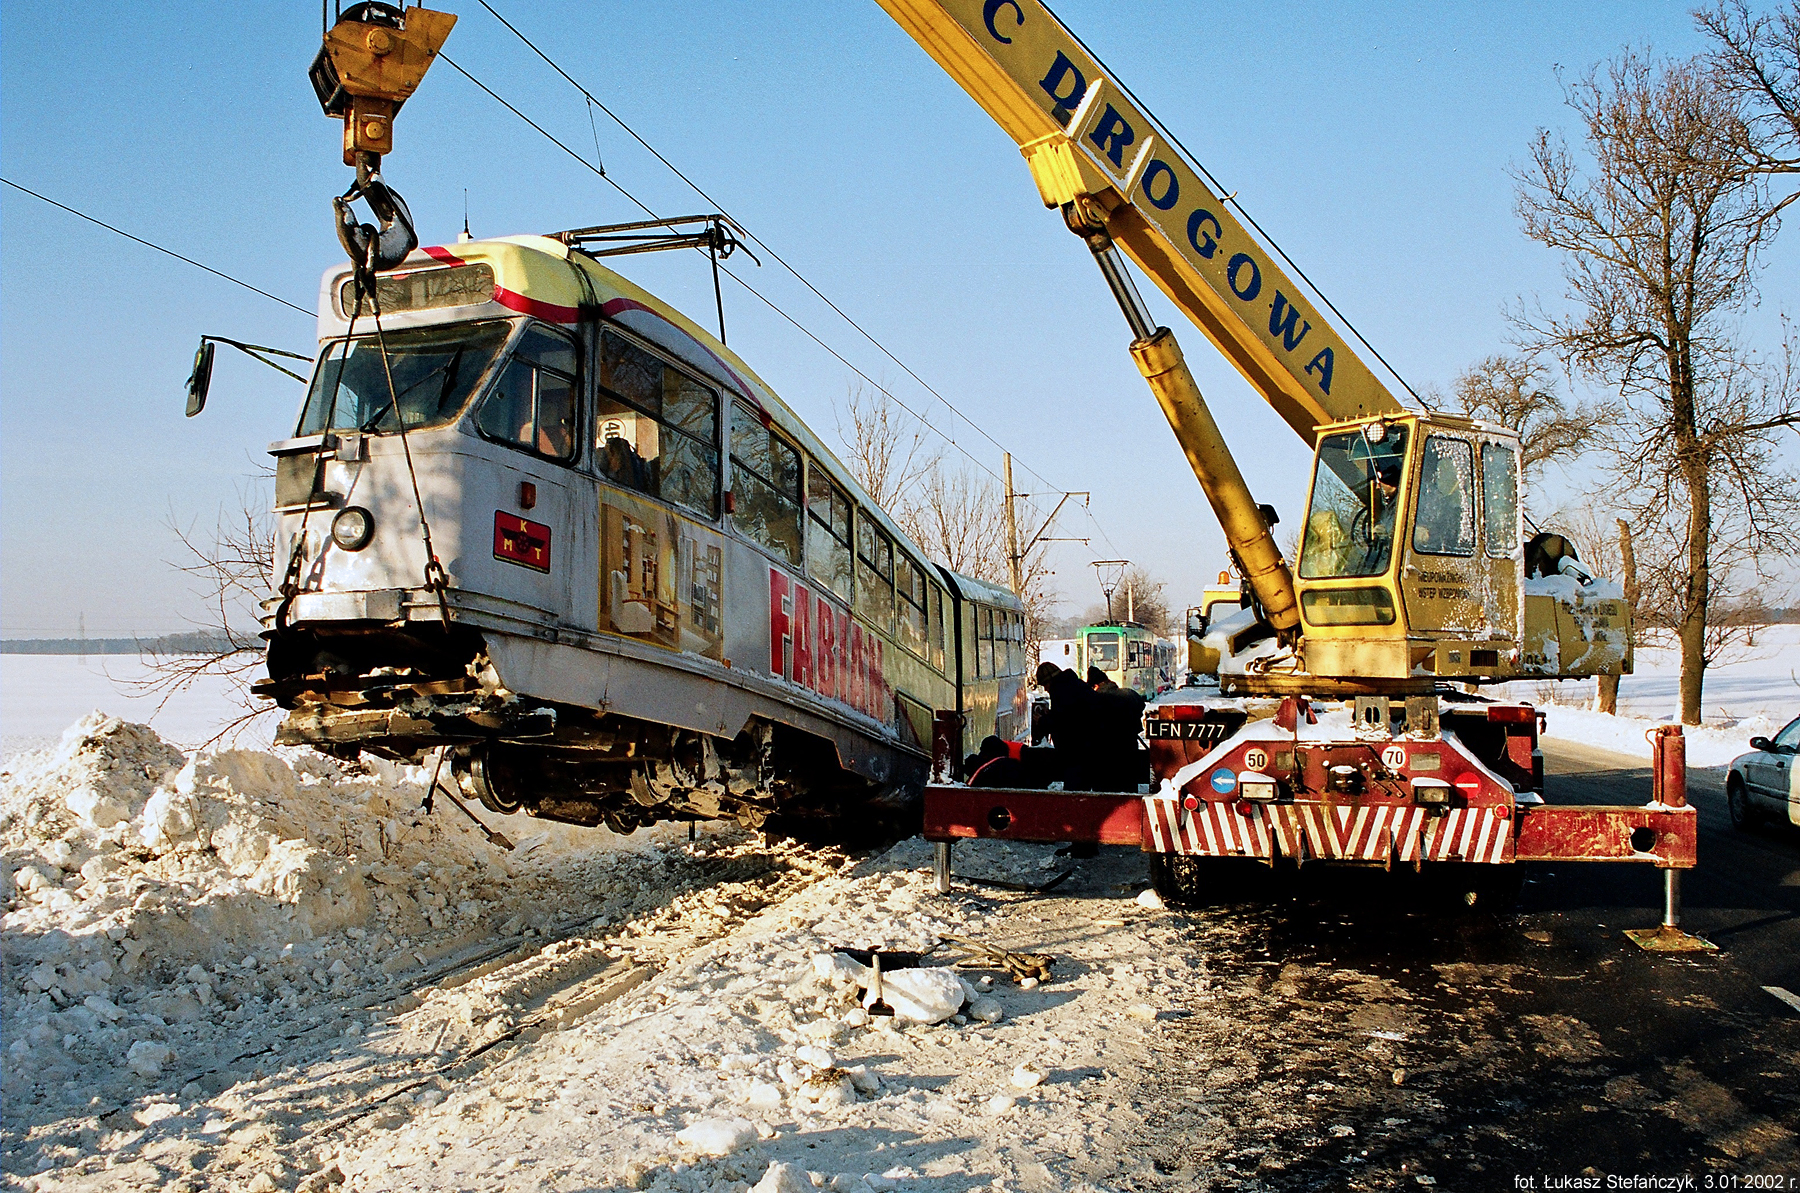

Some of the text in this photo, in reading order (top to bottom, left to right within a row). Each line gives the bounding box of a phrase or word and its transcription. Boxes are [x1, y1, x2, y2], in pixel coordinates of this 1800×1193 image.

[1038, 49, 1335, 396] DROGOWA
[1149, 722, 1226, 739] LFN 7777
[1248, 753, 1265, 768] 50
[1386, 751, 1403, 765] 70
